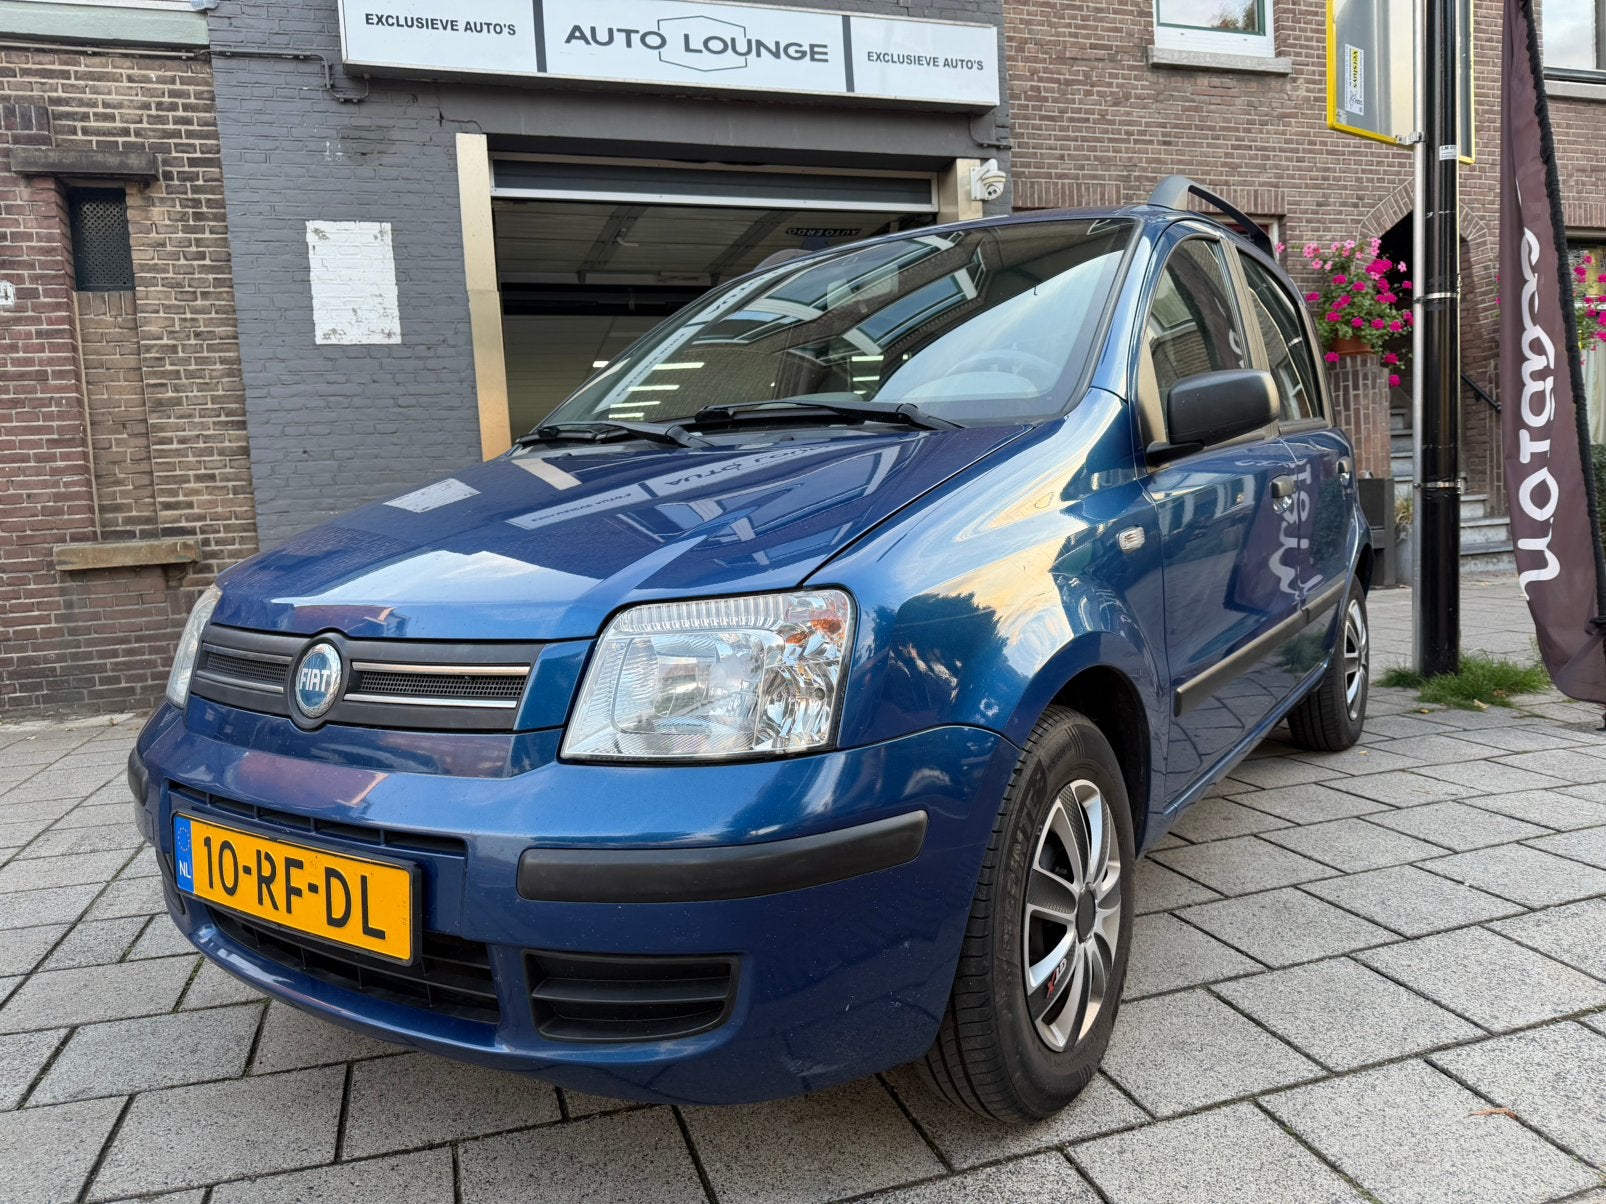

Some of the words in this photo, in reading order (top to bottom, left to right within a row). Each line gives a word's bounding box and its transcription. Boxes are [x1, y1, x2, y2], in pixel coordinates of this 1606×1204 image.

[365, 13, 459, 31] EXCLUSIEVE
[464, 21, 516, 36] AUTO'S
[564, 25, 667, 50] AUTO
[684, 33, 829, 63] LOUNGE
[867, 51, 940, 67] EXCLUSIEVE
[943, 57, 984, 71] AUTO'S
[300, 668, 331, 692] FIAT
[178, 859, 192, 879] NL
[203, 835, 386, 941] 10-RF-DL
